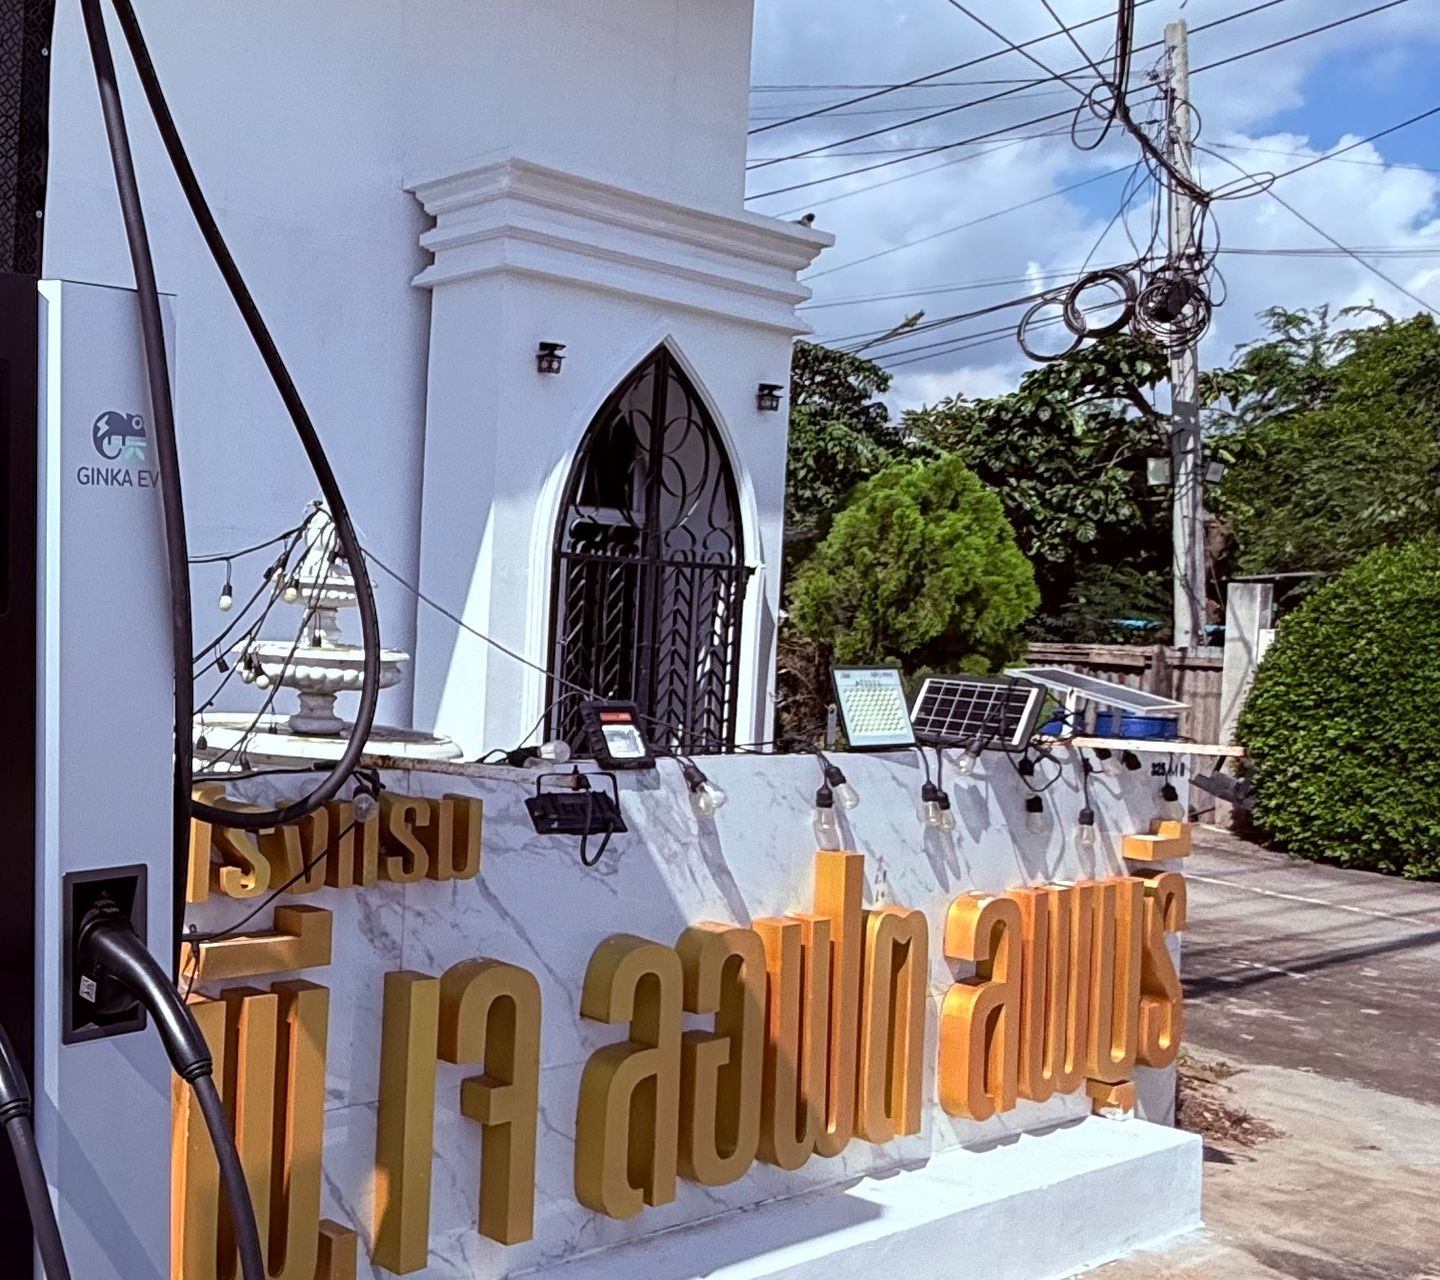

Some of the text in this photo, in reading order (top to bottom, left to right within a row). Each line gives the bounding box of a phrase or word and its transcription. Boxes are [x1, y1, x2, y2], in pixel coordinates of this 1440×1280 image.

[76, 466, 160, 488] GINKA EV
[937, 818, 1193, 1123] ลพบุรี
